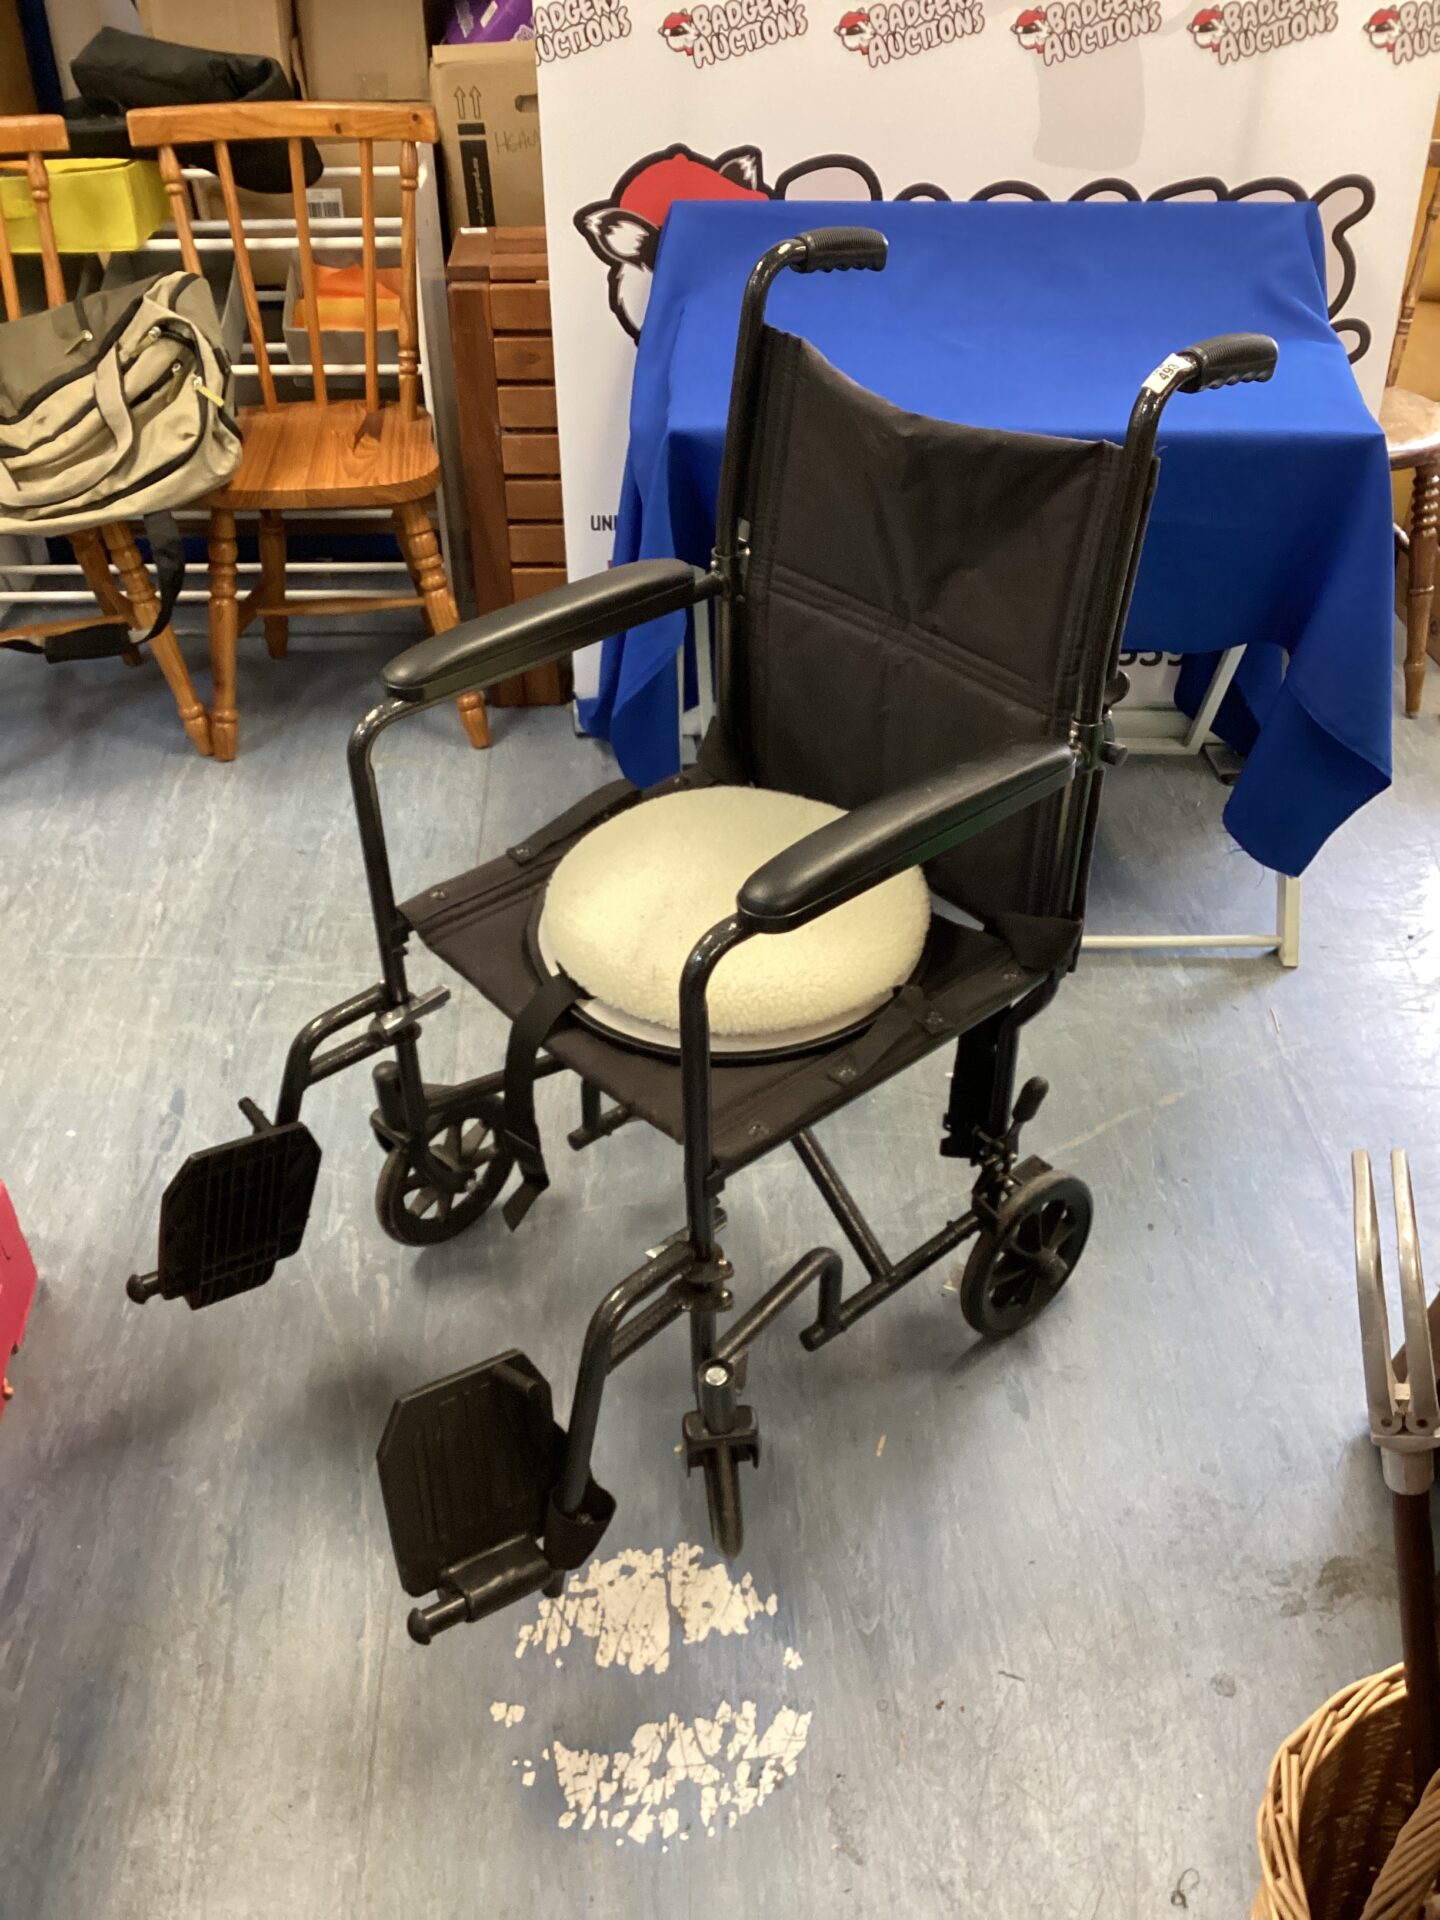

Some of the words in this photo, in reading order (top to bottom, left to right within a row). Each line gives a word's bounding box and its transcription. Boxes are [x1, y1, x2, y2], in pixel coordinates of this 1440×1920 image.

[535, 6, 633, 67] UCTIONS
[693, 3, 808, 69] AUCTIONS
[868, 2, 985, 68] AUCTIONS
[1043, 1, 1162, 67] AUCTIONS
[1046, 0, 1152, 34] BADGE
[1218, 0, 1339, 66] AUCTIONS
[1222, 0, 1331, 33] BADGE
[1158, 363, 1180, 381] 493
